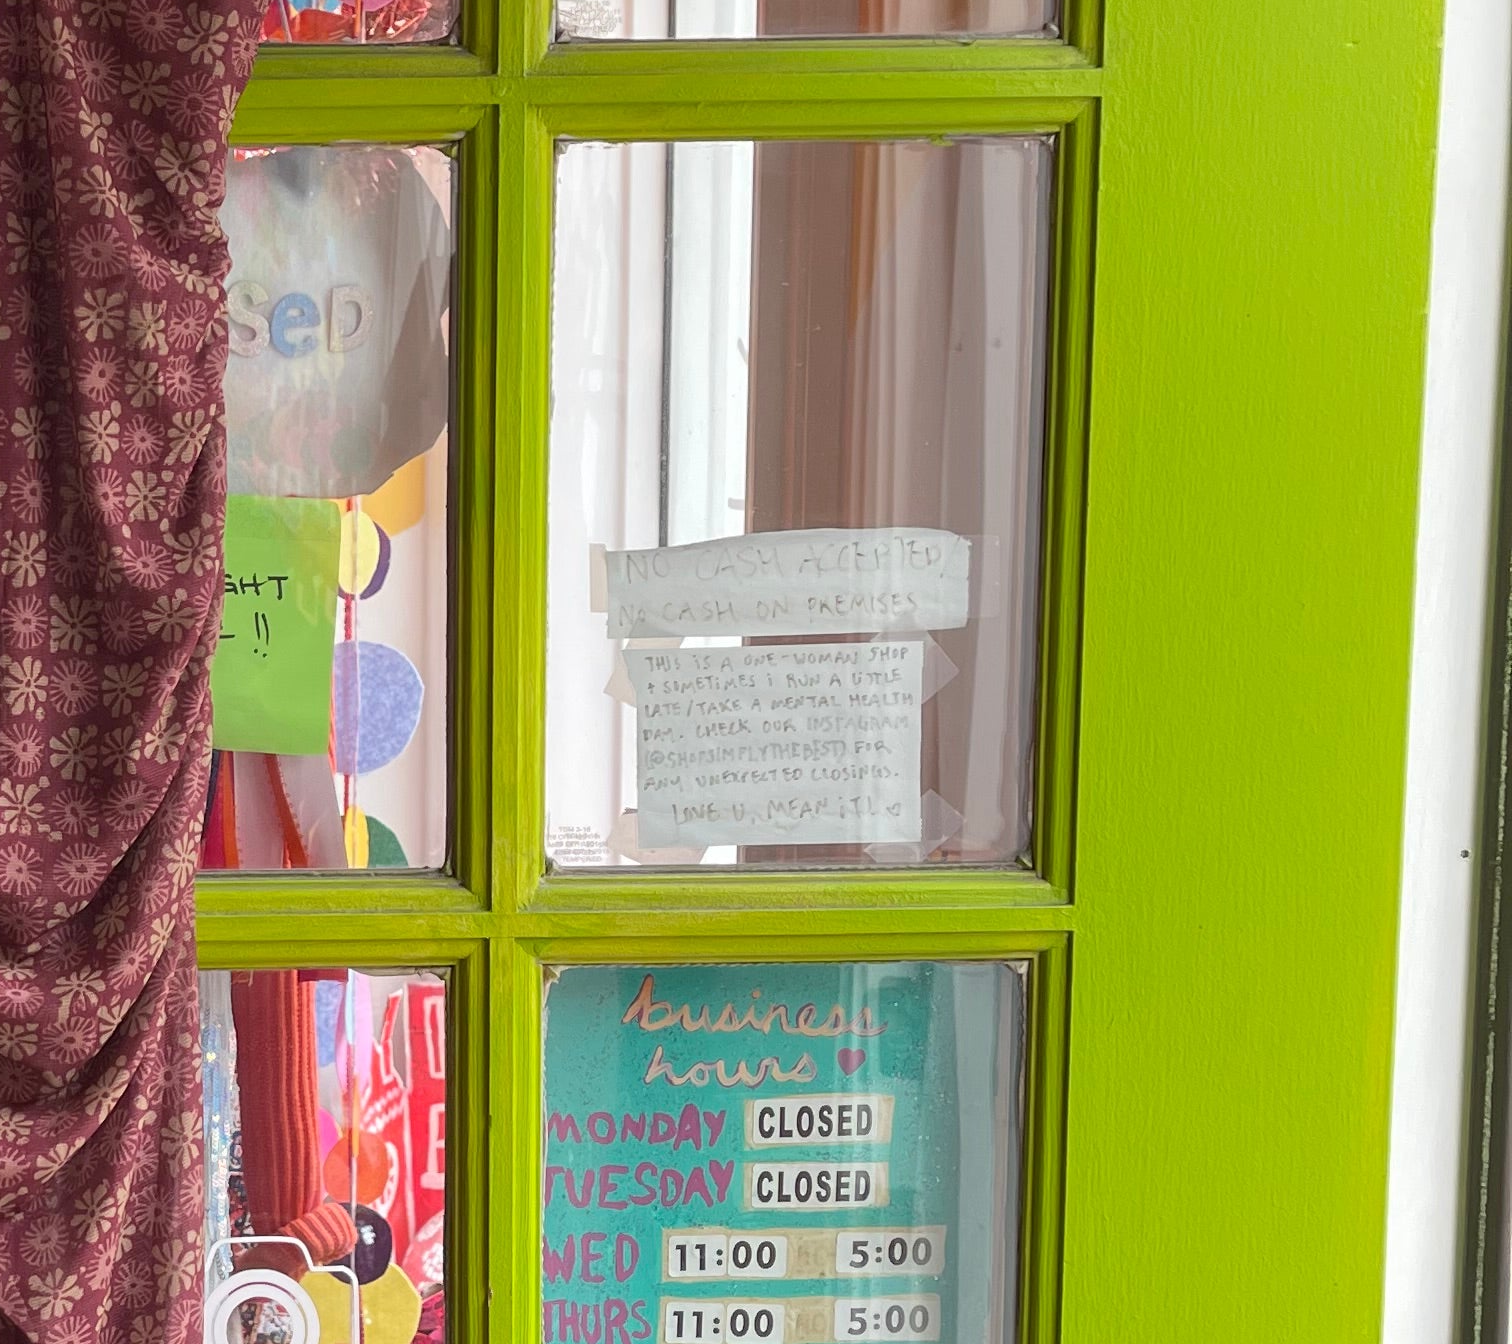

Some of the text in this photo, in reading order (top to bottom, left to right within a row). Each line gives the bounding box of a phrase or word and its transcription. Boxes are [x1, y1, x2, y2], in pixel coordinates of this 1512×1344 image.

[626, 552, 670, 584] NO
[695, 545, 785, 581] CASH
[662, 600, 738, 623] CASH
[756, 596, 789, 620] ON
[807, 592, 918, 624] PREMISES
[720, 656, 734, 672] A
[868, 646, 909, 662] SHOP
[786, 672, 820, 688] RUN
[829, 672, 842, 687] A
[751, 698, 762, 712] A
[771, 695, 841, 710] MENTAL
[849, 692, 913, 708] HEALTH
[696, 718, 752, 738] CHECK
[854, 740, 892, 755] FOR
[672, 802, 721, 826] LOVE
[768, 797, 828, 820] MEAN
[622, 974, 888, 1037] business
[644, 1045, 818, 1088] hours
[547, 1103, 873, 1151] MONDAY CLOSED
[544, 1159, 871, 1210] TUESDAY CLOSED
[543, 1231, 639, 1284] WED
[675, 1240, 777, 1272] 11:00
[849, 1237, 932, 1269] 5:00
[673, 1308, 774, 1339] 11:00
[847, 1305, 929, 1336] 5:00
